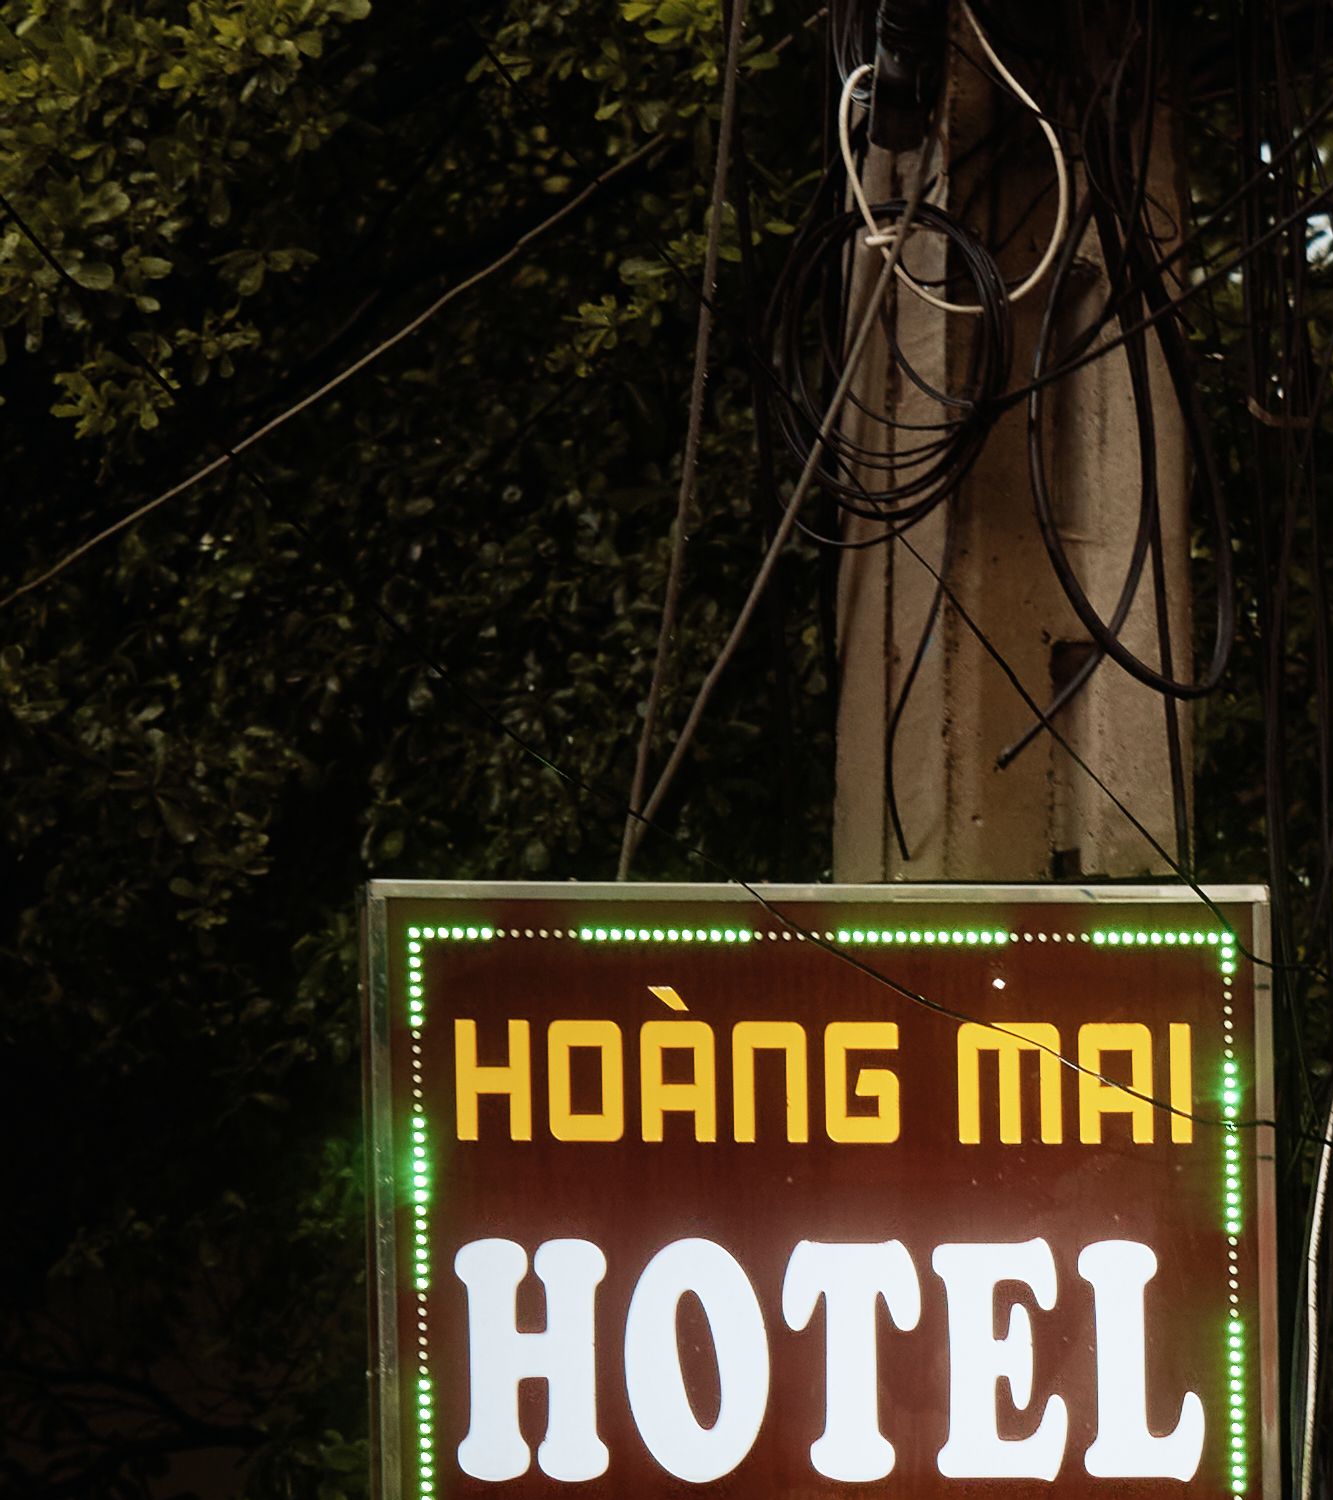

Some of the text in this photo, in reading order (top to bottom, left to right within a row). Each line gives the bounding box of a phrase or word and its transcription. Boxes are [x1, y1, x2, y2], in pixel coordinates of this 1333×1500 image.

[454, 986, 1193, 1145] HOÀNG MAI
[453, 1236, 1206, 1484] HOTEL
